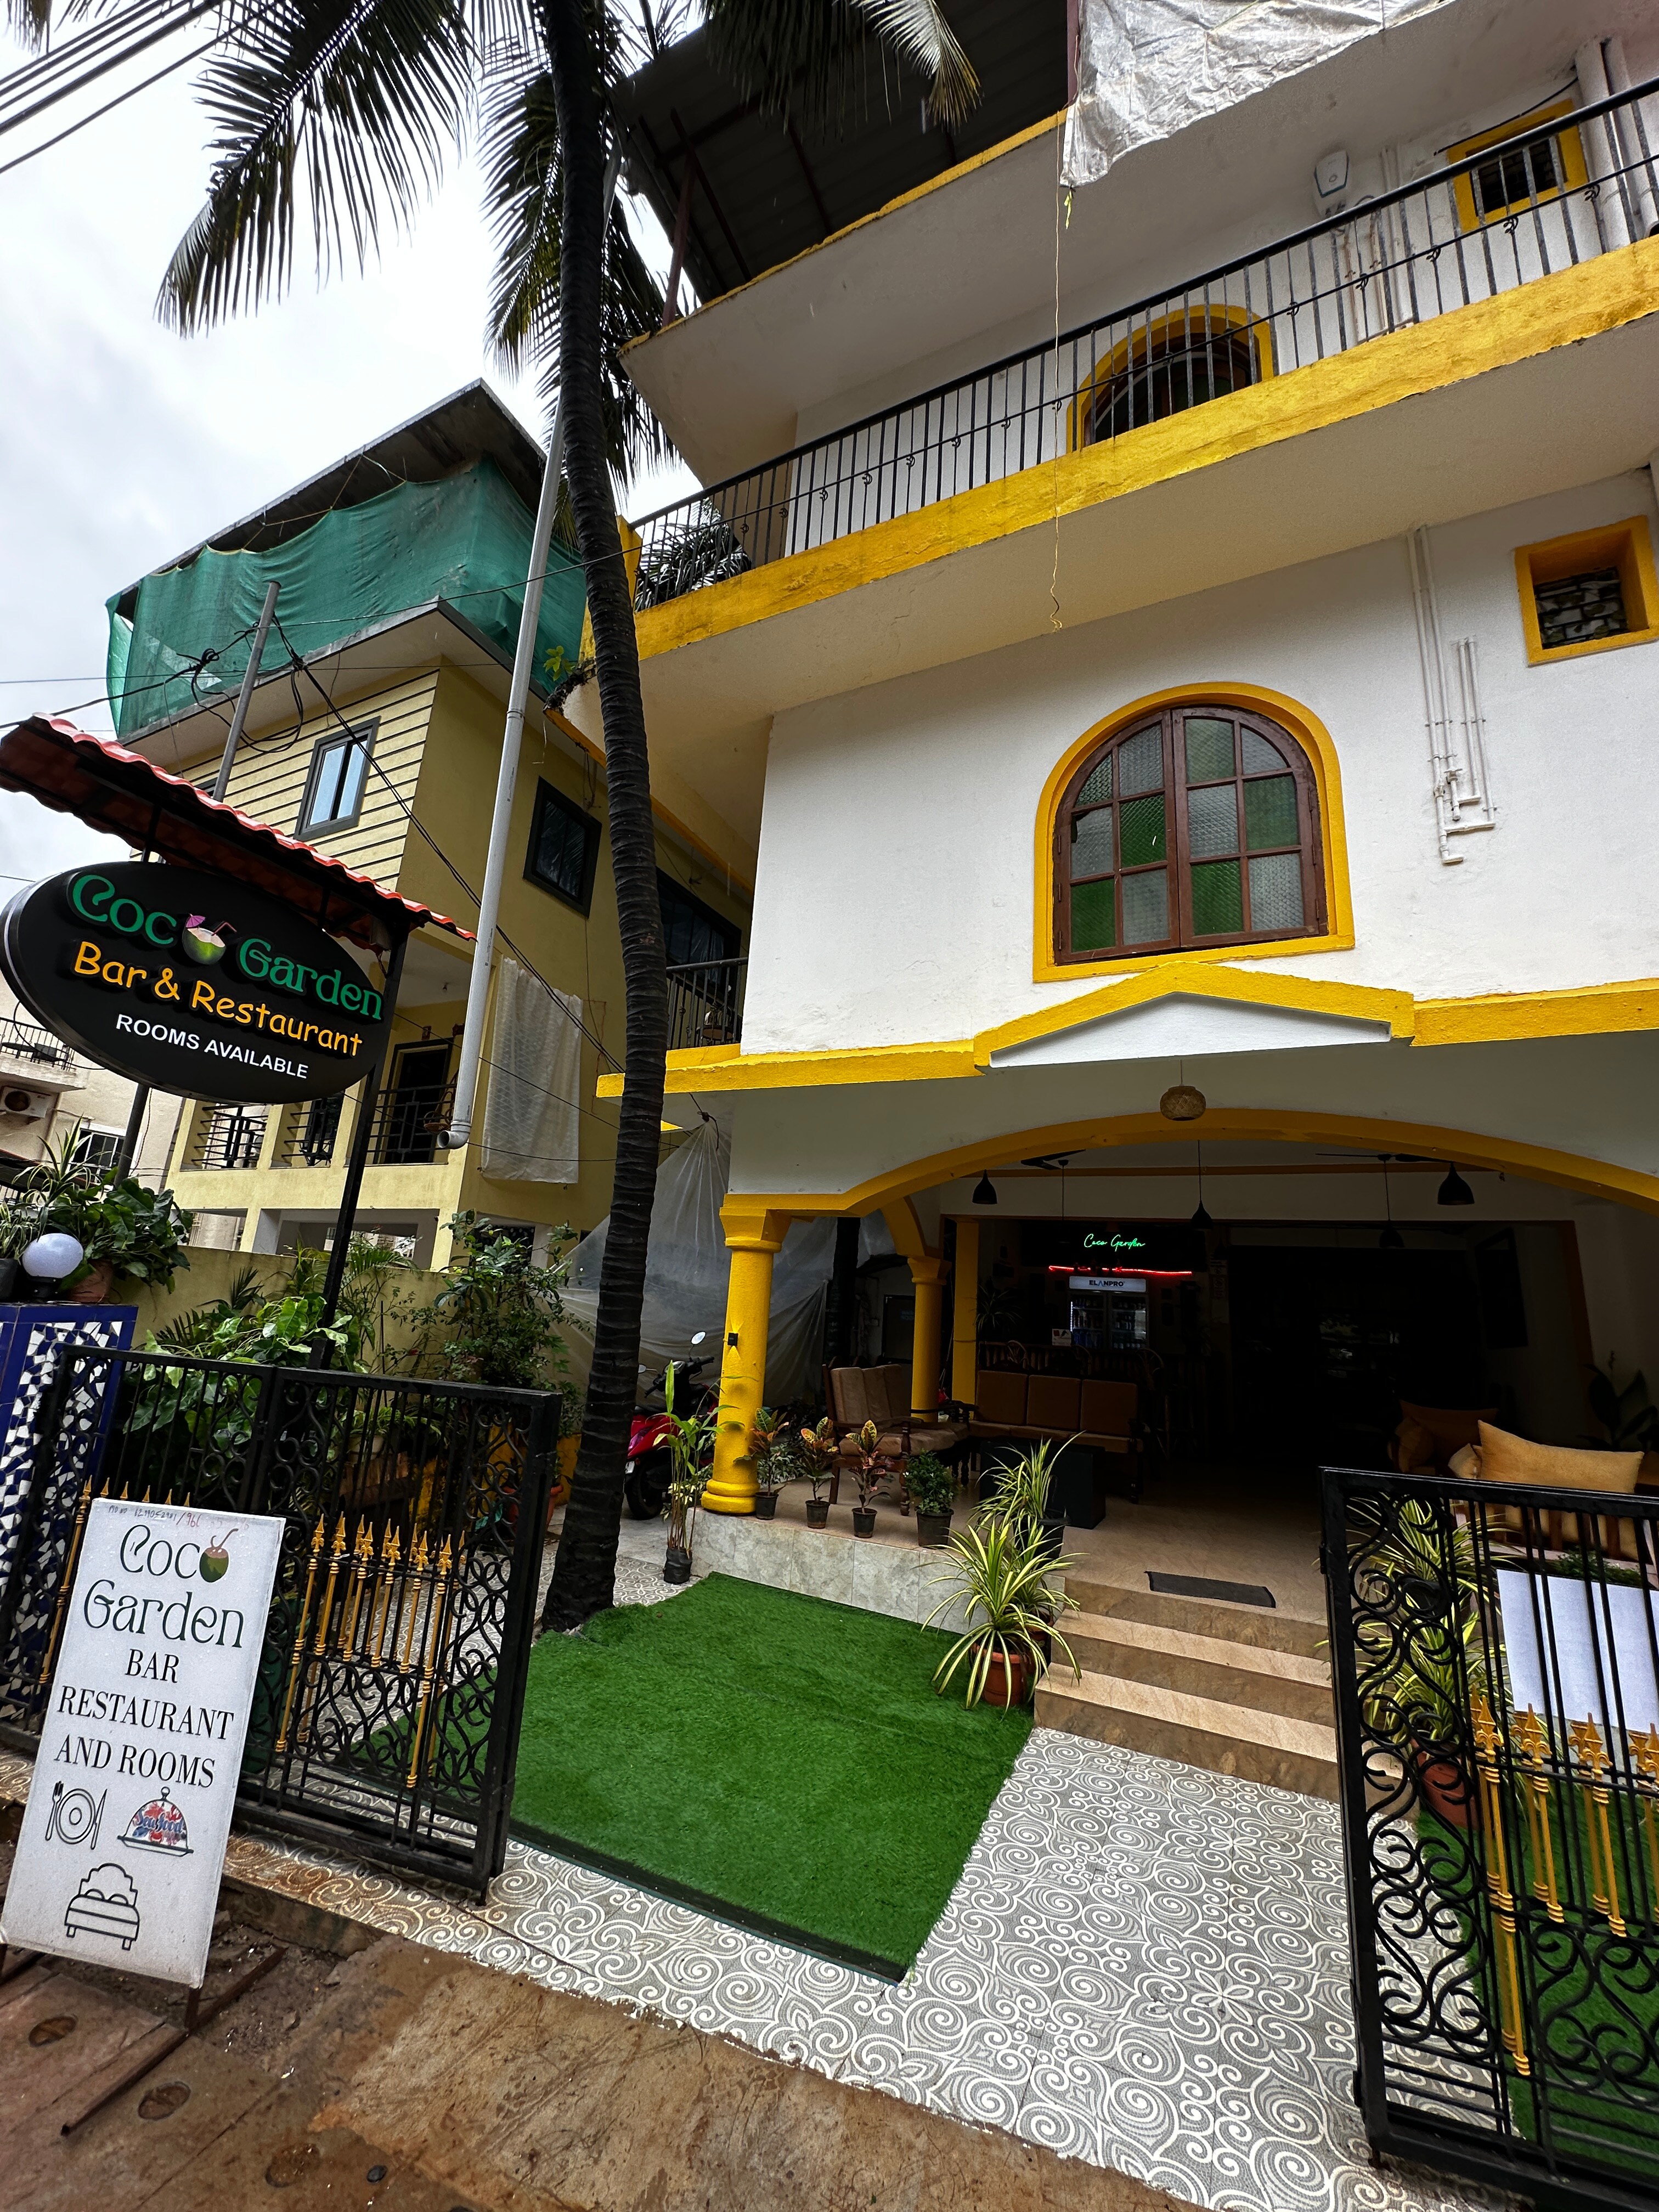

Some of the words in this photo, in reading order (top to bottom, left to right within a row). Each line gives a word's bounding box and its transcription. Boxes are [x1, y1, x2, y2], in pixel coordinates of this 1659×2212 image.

[75, 941, 146, 989] Bar
[154, 966, 180, 1001] &
[192, 980, 363, 1056] Restaurant
[240, 938, 382, 1020] Garden
[116, 1014, 200, 1050] ROOMS
[205, 1039, 309, 1079] AVAILABLE
[1084, 1233, 1108, 1248] Coco
[1110, 1234, 1146, 1252] Garden
[84, 1579, 244, 1648] Garden
[125, 1649, 180, 1683] BAR
[57, 1685, 234, 1740] RESTAURANT
[54, 1734, 112, 1769] AND
[117, 1744, 215, 1788] ROOMS
